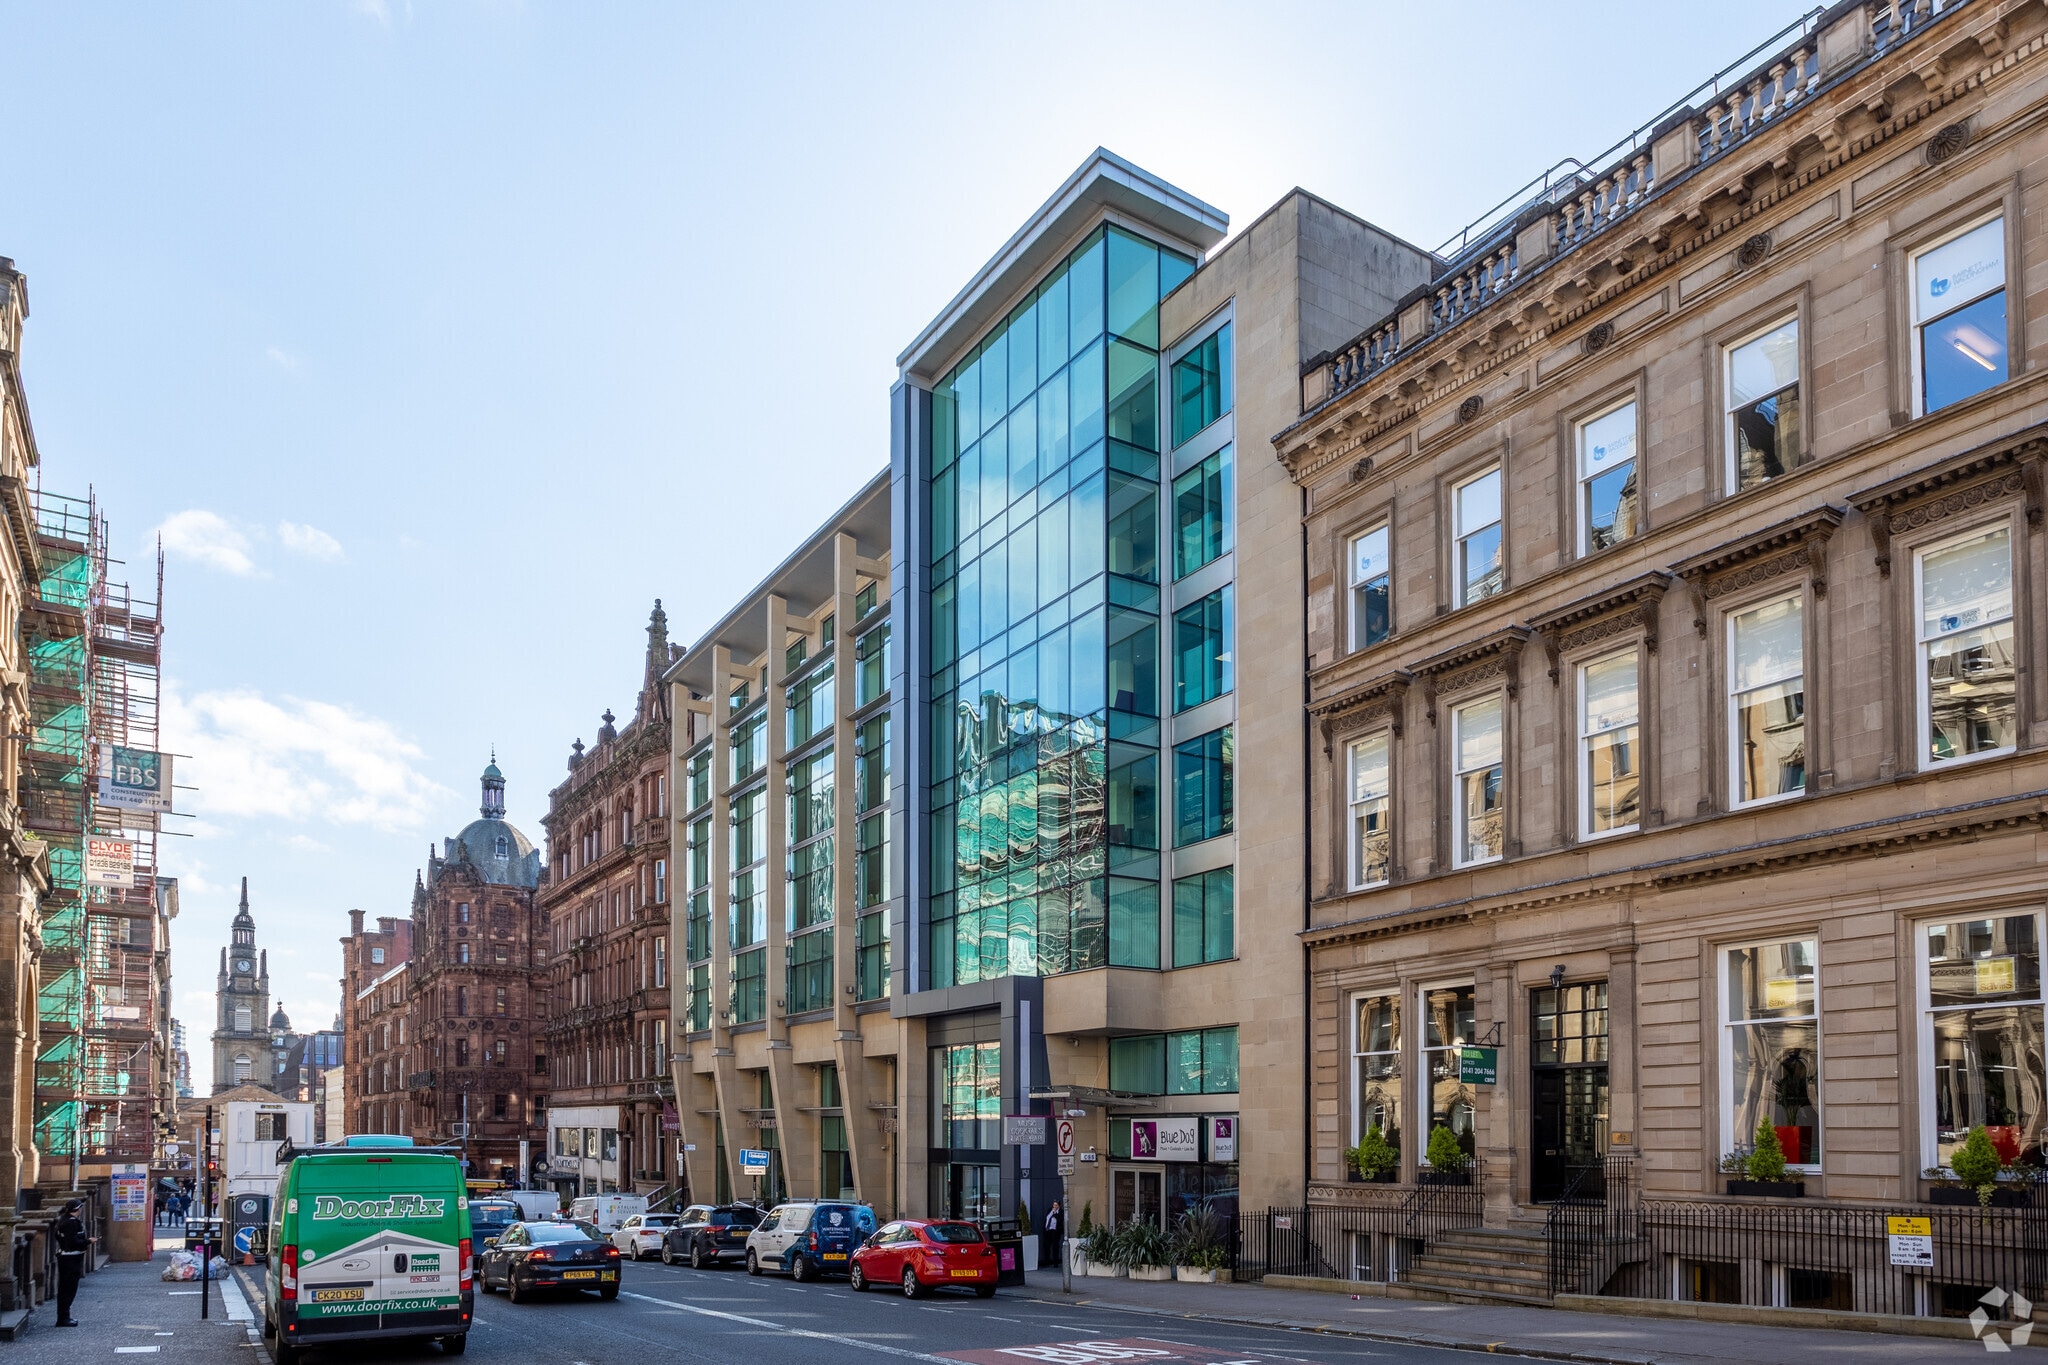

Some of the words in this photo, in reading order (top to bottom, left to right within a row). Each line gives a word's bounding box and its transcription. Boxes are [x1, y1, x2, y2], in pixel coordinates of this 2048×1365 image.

[115, 764, 157, 787] EBS
[111, 788, 160, 798] CONSTRUCTION
[89, 840, 131, 853] CLYDE
[90, 850, 131, 860] SCAFFOLDING
[313, 1195, 444, 1219] DoorFix
[317, 1291, 342, 1300] CK20
[344, 1290, 362, 1298] YSU
[322, 1298, 437, 1314] www.doorfix.co.uk
[994, 1341, 1170, 1364] BUS
